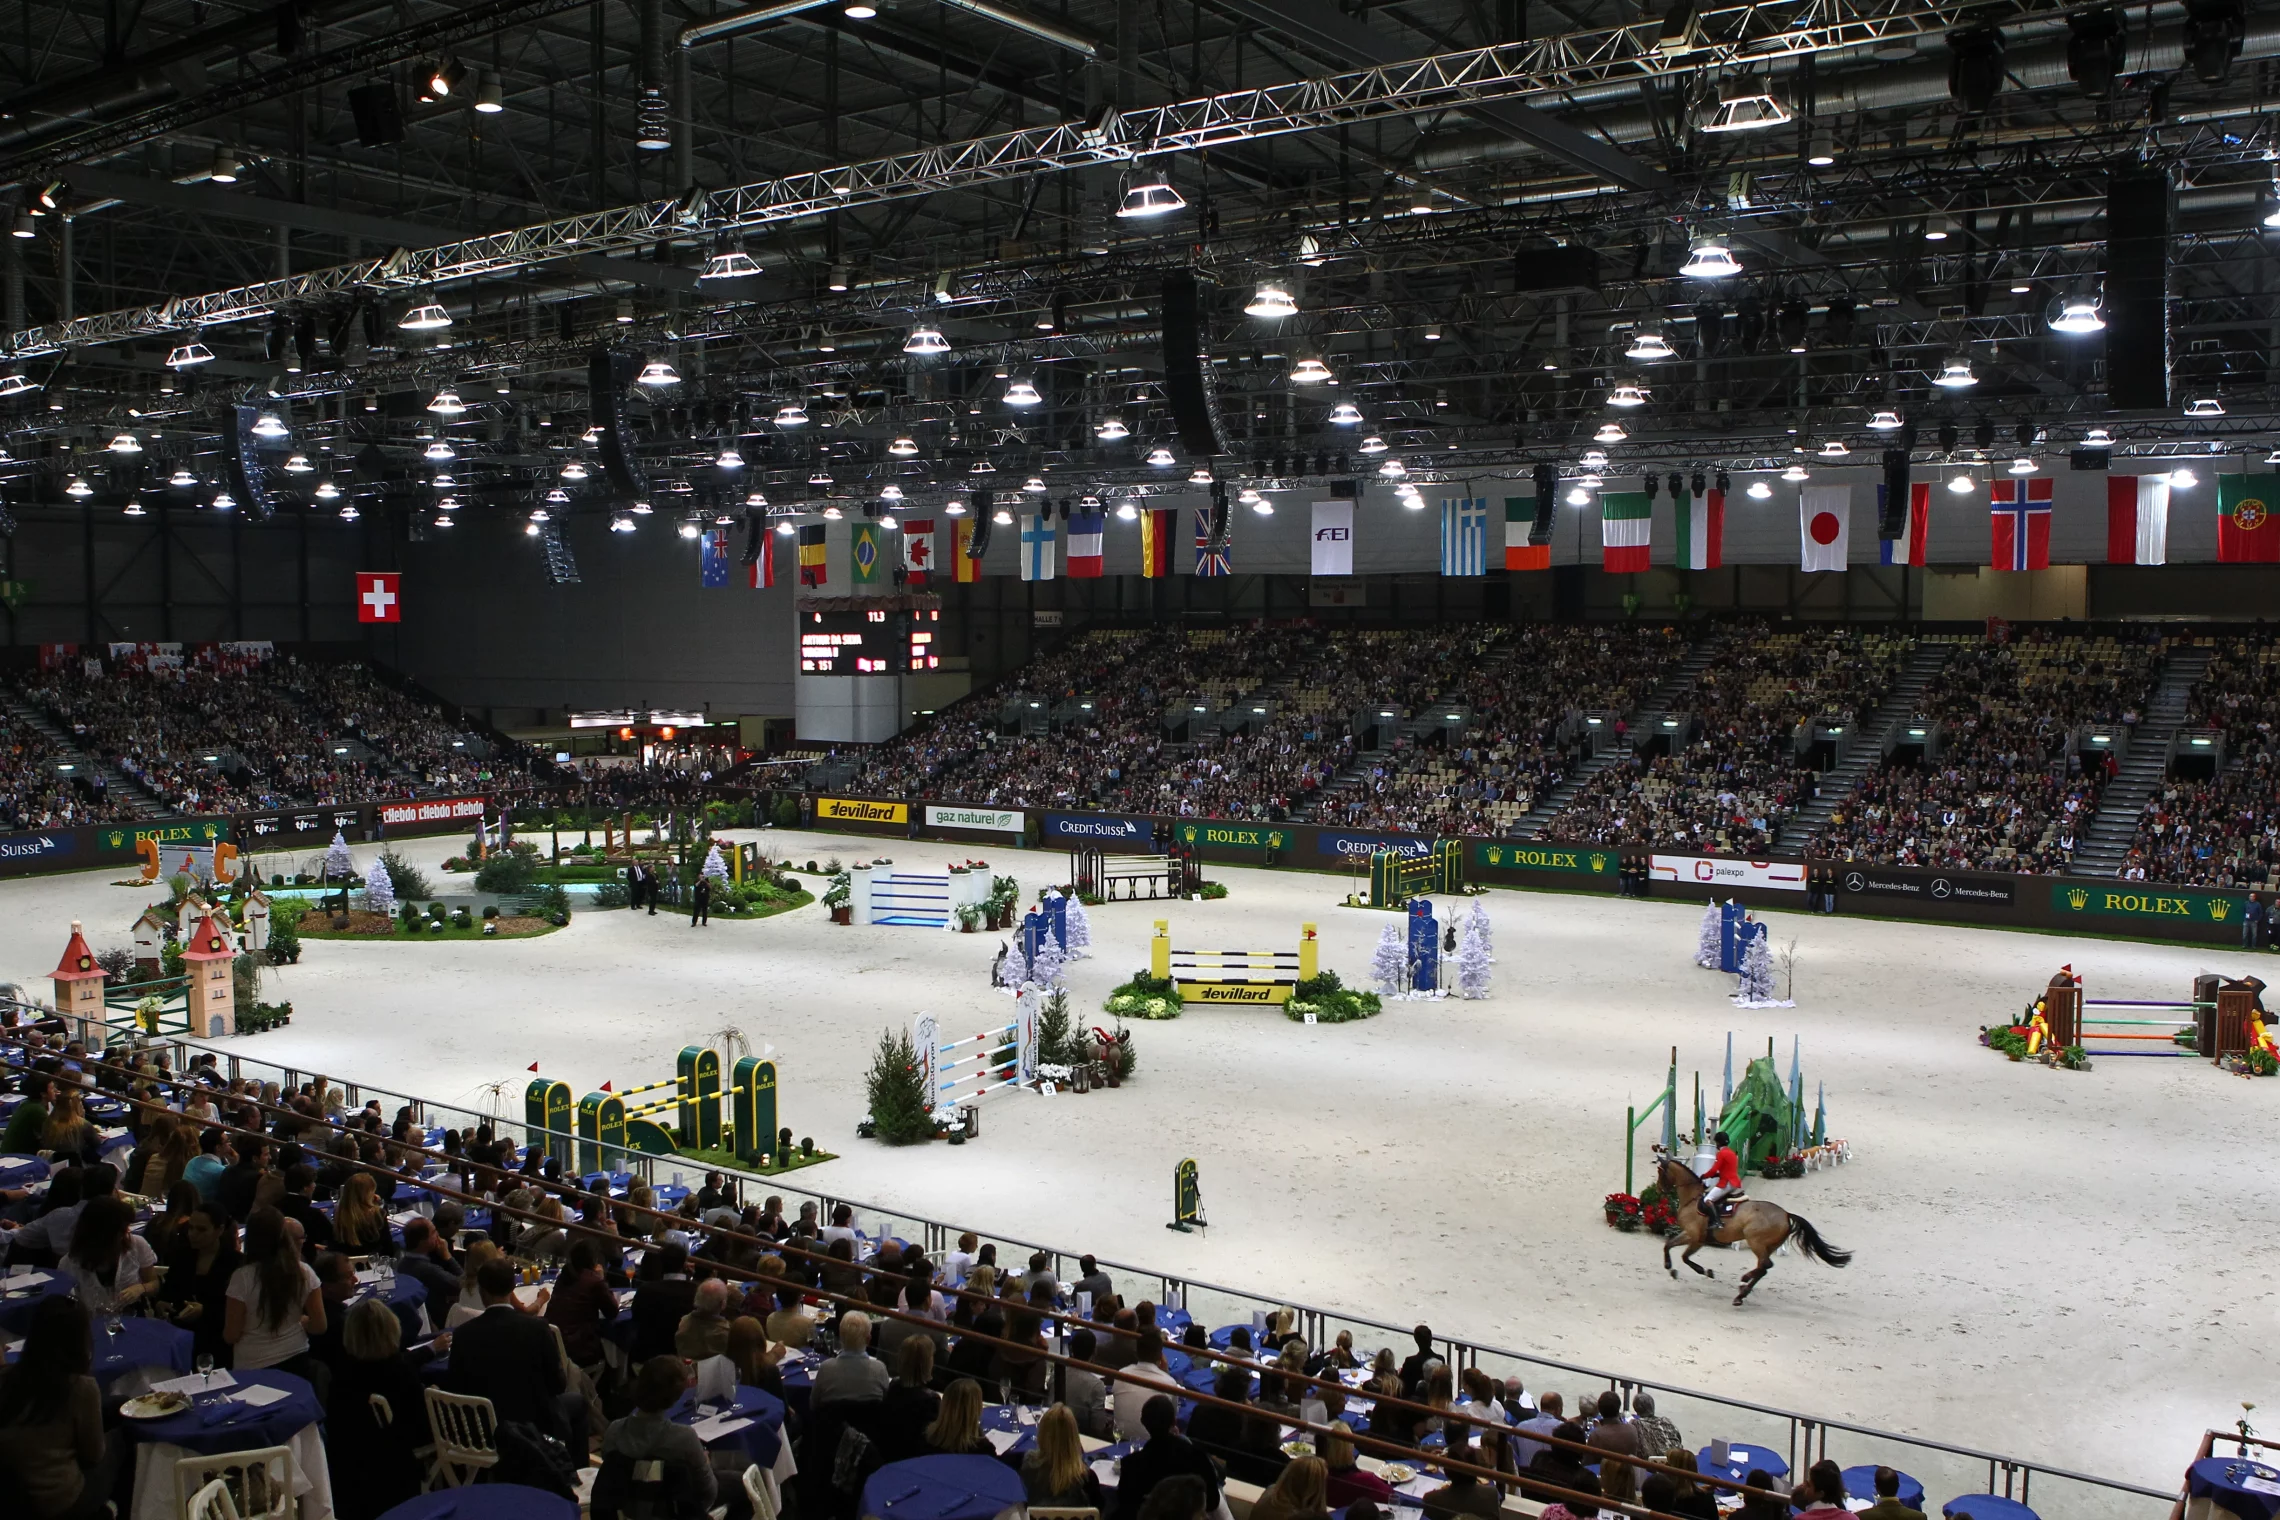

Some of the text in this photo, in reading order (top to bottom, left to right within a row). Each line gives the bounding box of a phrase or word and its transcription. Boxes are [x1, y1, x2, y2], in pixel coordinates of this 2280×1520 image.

[1315, 527, 1349, 541] FEI
[829, 801, 895, 820] devillard
[936, 811, 995, 825] gaz naturel
[134, 827, 193, 841] ROLEX
[1060, 820, 1126, 837] CREDIT SUISSE
[1206, 829, 1260, 845] ROLEX
[1, 842, 42, 857] SUISSE
[1336, 839, 1378, 854] CREDIT
[1514, 850, 1577, 868] ROLEX
[1716, 867, 1744, 878] palexpo
[1868, 881, 1920, 892] Mercedes-Benz
[1954, 887, 2009, 899] Mercedes-Benz
[2104, 893, 2191, 915] ROLEX
[1201, 987, 1271, 1000] devillard
[1307, 1014, 1314, 1023] 3
[699, 1069, 718, 1079] ROLEX
[756, 1081, 775, 1091] ROLEX
[1045, 1084, 1053, 1094] 9
[549, 1103, 570, 1114] ROLEX
[581, 1107, 595, 1116] ROLEX
[601, 1120, 624, 1131] ROLEX
